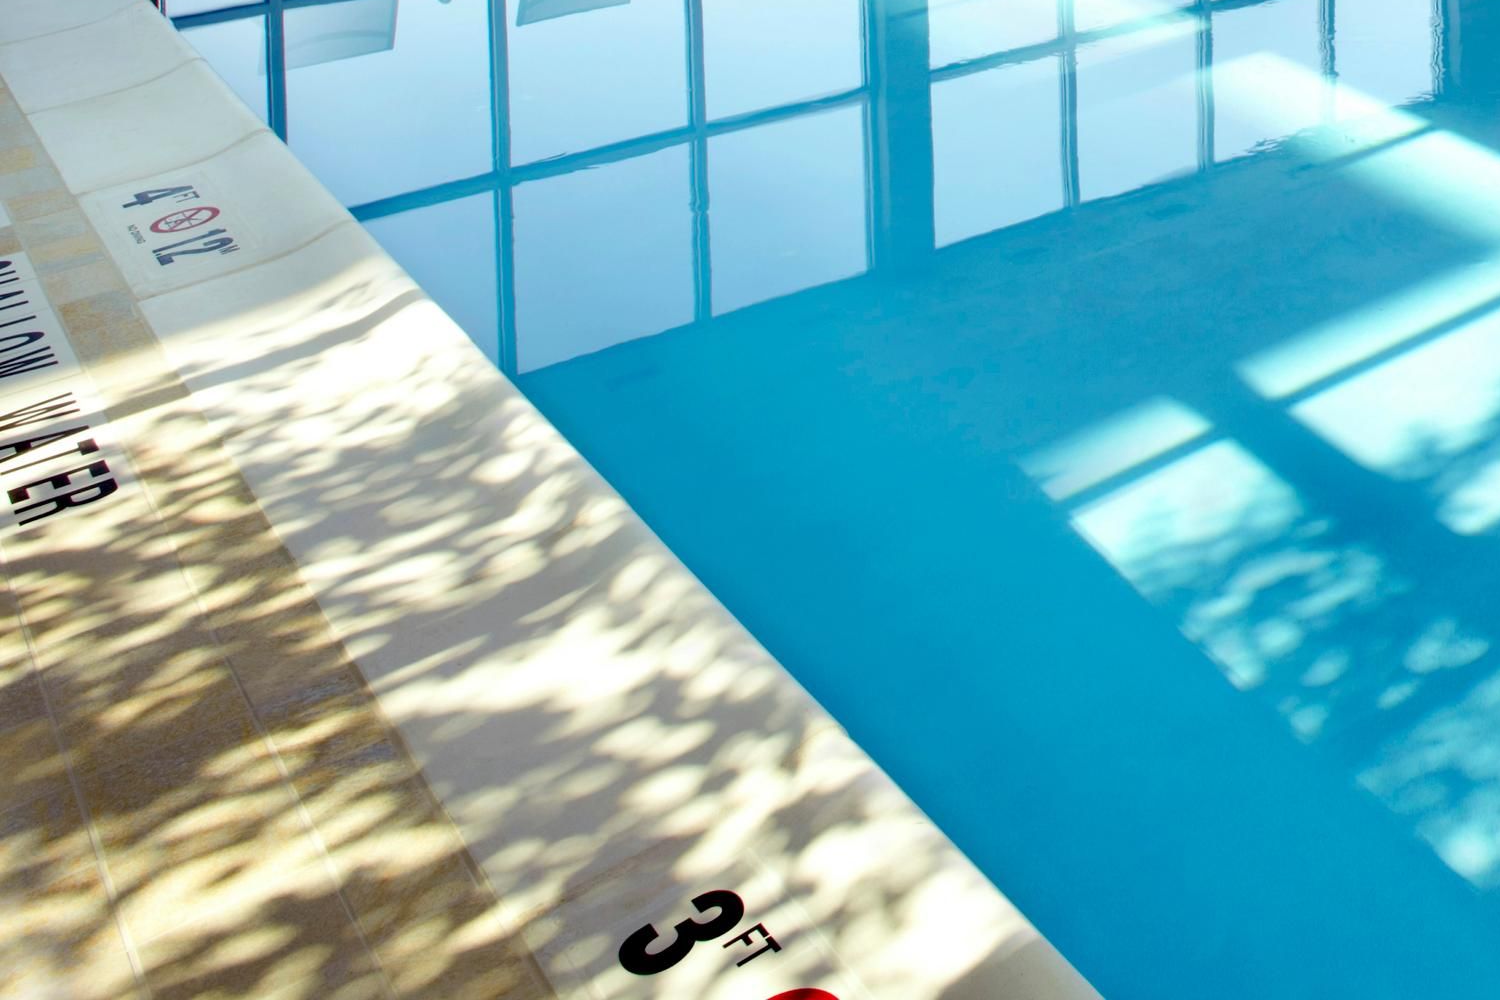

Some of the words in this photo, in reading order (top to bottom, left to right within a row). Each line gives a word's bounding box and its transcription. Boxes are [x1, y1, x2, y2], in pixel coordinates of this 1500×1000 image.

[122, 185, 194, 209] 4
[618, 889, 745, 976] 3
[722, 922, 782, 967] FT
